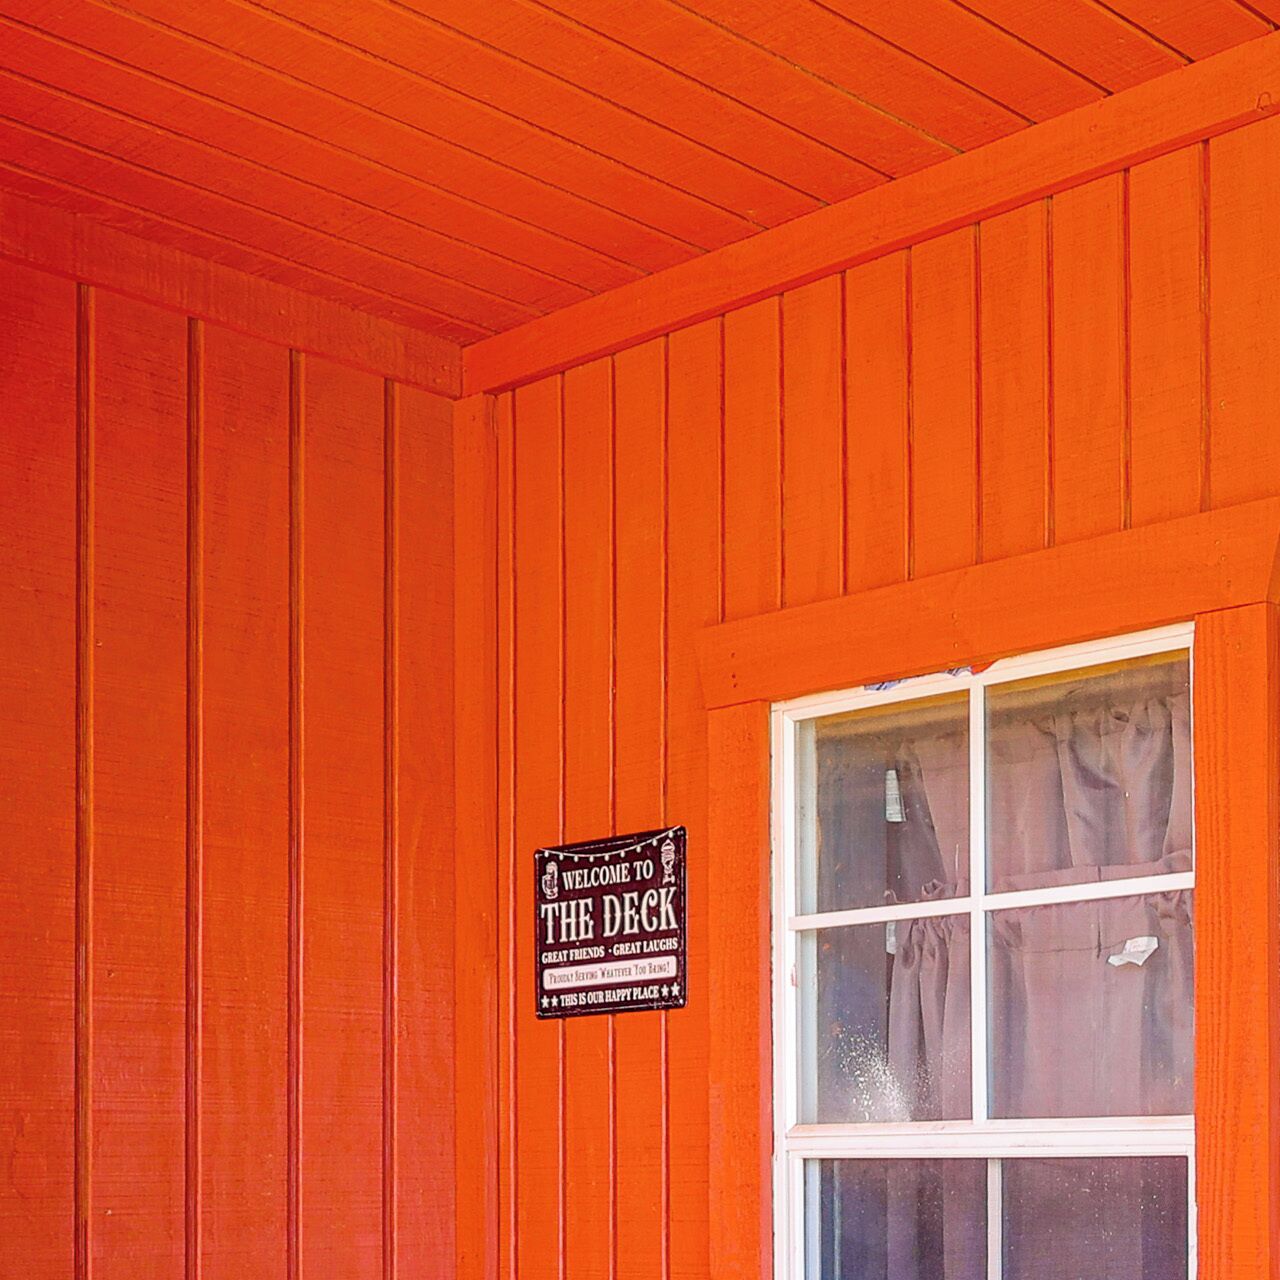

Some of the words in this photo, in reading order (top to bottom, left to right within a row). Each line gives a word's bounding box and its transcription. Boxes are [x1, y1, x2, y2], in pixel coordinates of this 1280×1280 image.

[562, 863, 630, 890] WELCOME
[633, 859, 654, 880] TO
[541, 898, 594, 944] THE
[603, 887, 678, 937] DECK
[542, 951, 569, 964] GREAT
[570, 946, 605, 960] FRIENDS
[613, 942, 641, 955] GREAT
[643, 938, 677, 952] LAUGHS
[560, 993, 578, 1006] THIS
[579, 993, 587, 1004] IS
[588, 991, 604, 1004] OUR
[605, 988, 632, 1002] HAPPY
[633, 986, 659, 999] PLACE
